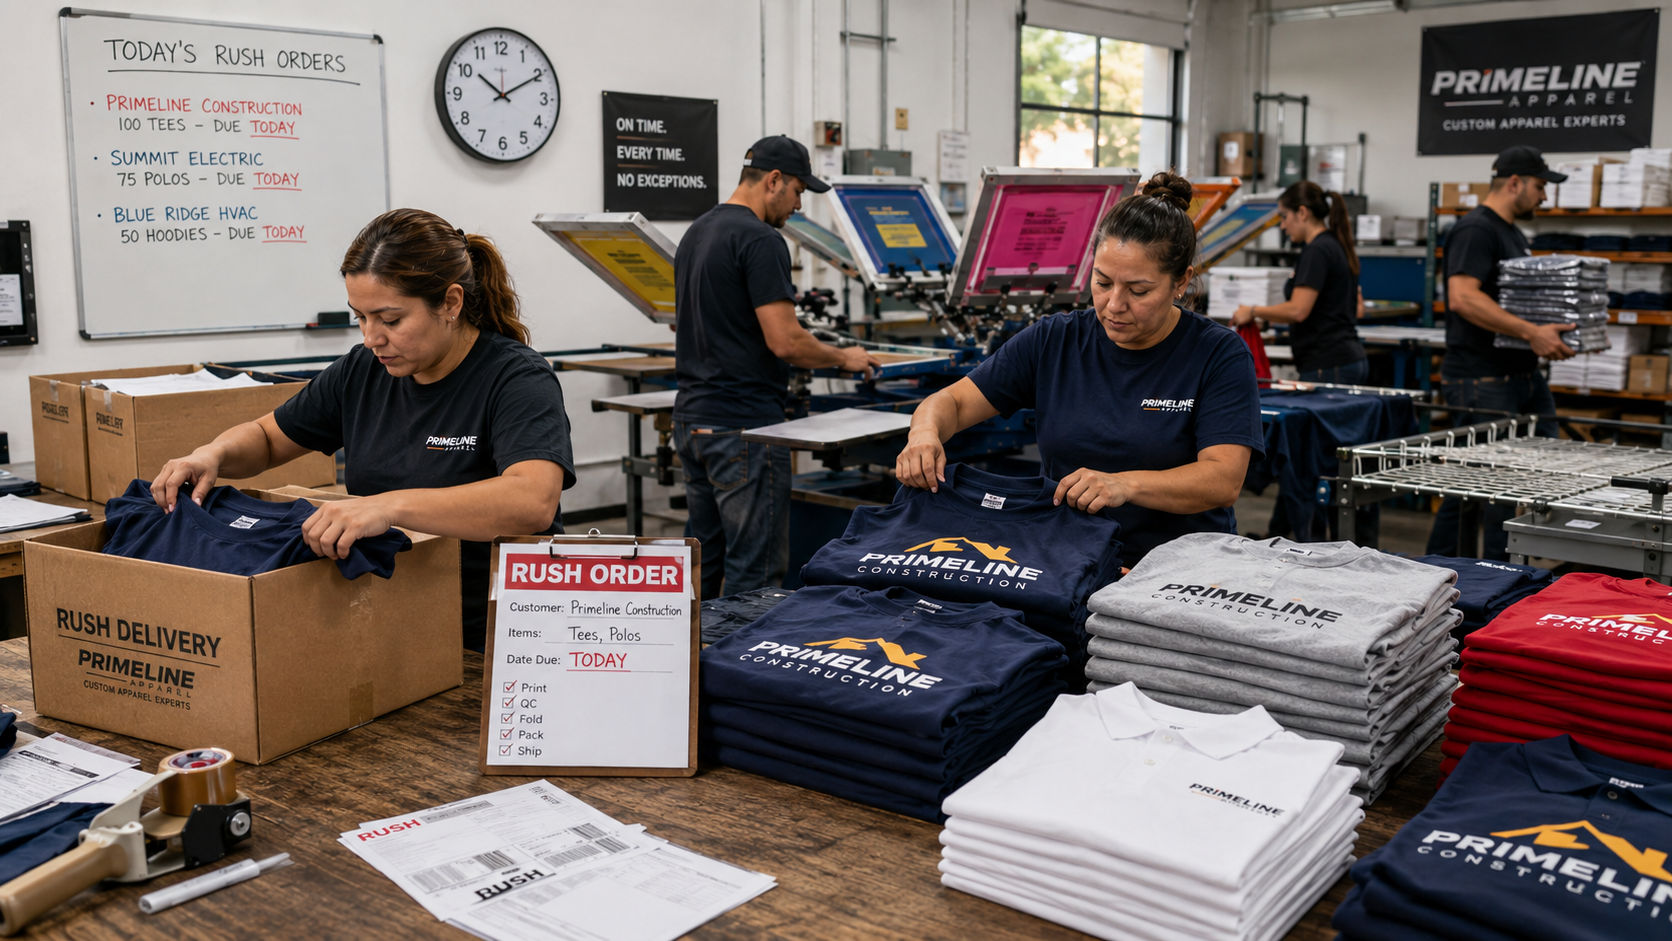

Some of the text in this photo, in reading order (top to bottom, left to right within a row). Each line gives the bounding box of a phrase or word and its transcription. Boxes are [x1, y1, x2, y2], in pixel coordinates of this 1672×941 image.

[104, 39, 346, 73] TODAY'S RUSH ORDERS
[474, 46, 485, 60] 11
[494, 41, 508, 56] 12
[520, 50, 525, 63] 1
[458, 63, 473, 78] 10
[533, 68, 543, 83] 2
[1430, 61, 1642, 96] PRIMELINE
[453, 87, 462, 101] 9
[539, 92, 548, 107] 3
[1508, 91, 1634, 108] APPAREL
[106, 94, 302, 116] PRIMELINE CONSTRUCTION
[118, 117, 141, 132] 100
[147, 118, 186, 132] TEES
[213, 119, 242, 134] DUE
[250, 120, 296, 136] TODAY
[460, 111, 470, 125] 8
[533, 115, 543, 129] 4
[616, 117, 667, 134] ON TIME.
[1443, 114, 1626, 131] CUSTOM APPAREL EXPERTS
[478, 129, 486, 143] 7
[498, 136, 508, 151] 6
[519, 131, 529, 145] 5
[110, 149, 264, 167] SUMMIT ELECTRIC
[617, 146, 685, 161] EVERY TIME.
[117, 172, 136, 187] 75
[144, 171, 191, 187] POLOS
[217, 172, 245, 186] DUE
[253, 171, 300, 187] TODAY
[617, 173, 707, 189] NO EXCEPTIONS.
[113, 206, 258, 223] BLUE RIDGE HVAC
[121, 228, 140, 244] 50
[146, 227, 207, 243] HOODIES
[228, 226, 256, 241] DUE
[262, 224, 306, 240] TODAY
[1140, 399, 1195, 408] PRIMELINE
[425, 436, 478, 446] PRIMELINE
[511, 562, 678, 586] RUSH ORDER
[859, 552, 1043, 582] PRIMELINE
[857, 565, 1027, 590] CONSTRUCTION
[509, 600, 682, 616] Customer: Primeline Construction
[1151, 593, 1324, 629] CONSTRUCTION
[1158, 583, 1343, 623] PRIMELINE
[56, 607, 221, 658] RUSH DELIVERY
[508, 626, 641, 644] Items: Tees, Polos
[78, 648, 195, 689] PRIMELINE
[507, 652, 627, 668] Date Due: TODAY
[748, 640, 943, 689] PRIMELINE
[739, 653, 912, 697] CONSTRUCTION
[83, 679, 191, 710] CUSTOM APPAREL EXPERTS
[130, 679, 191, 698] APPAREL
[521, 683, 547, 693] Print
[520, 699, 537, 709] QC
[519, 715, 543, 724] Fold
[519, 730, 544, 740] Pack
[518, 746, 542, 758] Ship
[1189, 783, 1285, 816] PRIMELINE
[357, 819, 421, 842] RUSH
[474, 869, 545, 900] RUSH
[1417, 846, 1672, 924] CONSTRUCTI
